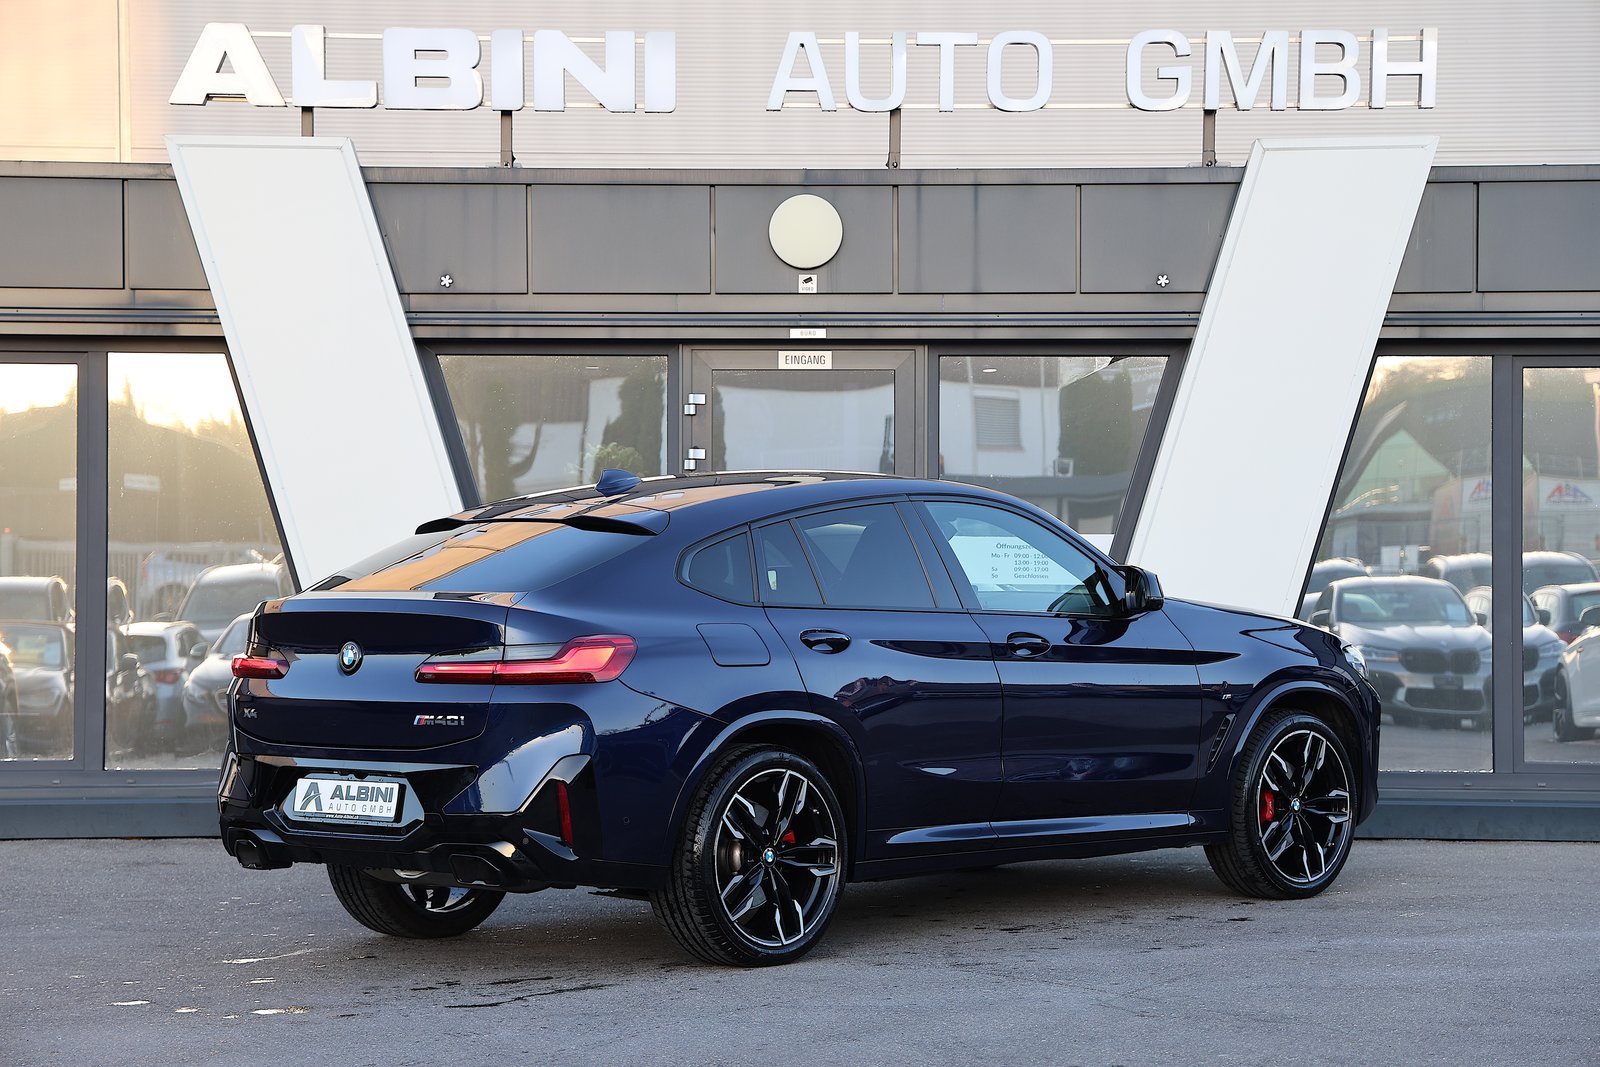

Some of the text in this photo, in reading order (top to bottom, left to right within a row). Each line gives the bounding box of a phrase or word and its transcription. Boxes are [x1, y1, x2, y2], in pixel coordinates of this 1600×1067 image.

[169, 22, 1438, 113] ALBINI AUTO GMBH
[785, 355, 826, 364] EINGANG
[243, 708, 257, 718] X4
[330, 785, 394, 802] ALBINI
[328, 802, 392, 814] AUTO GMBH
